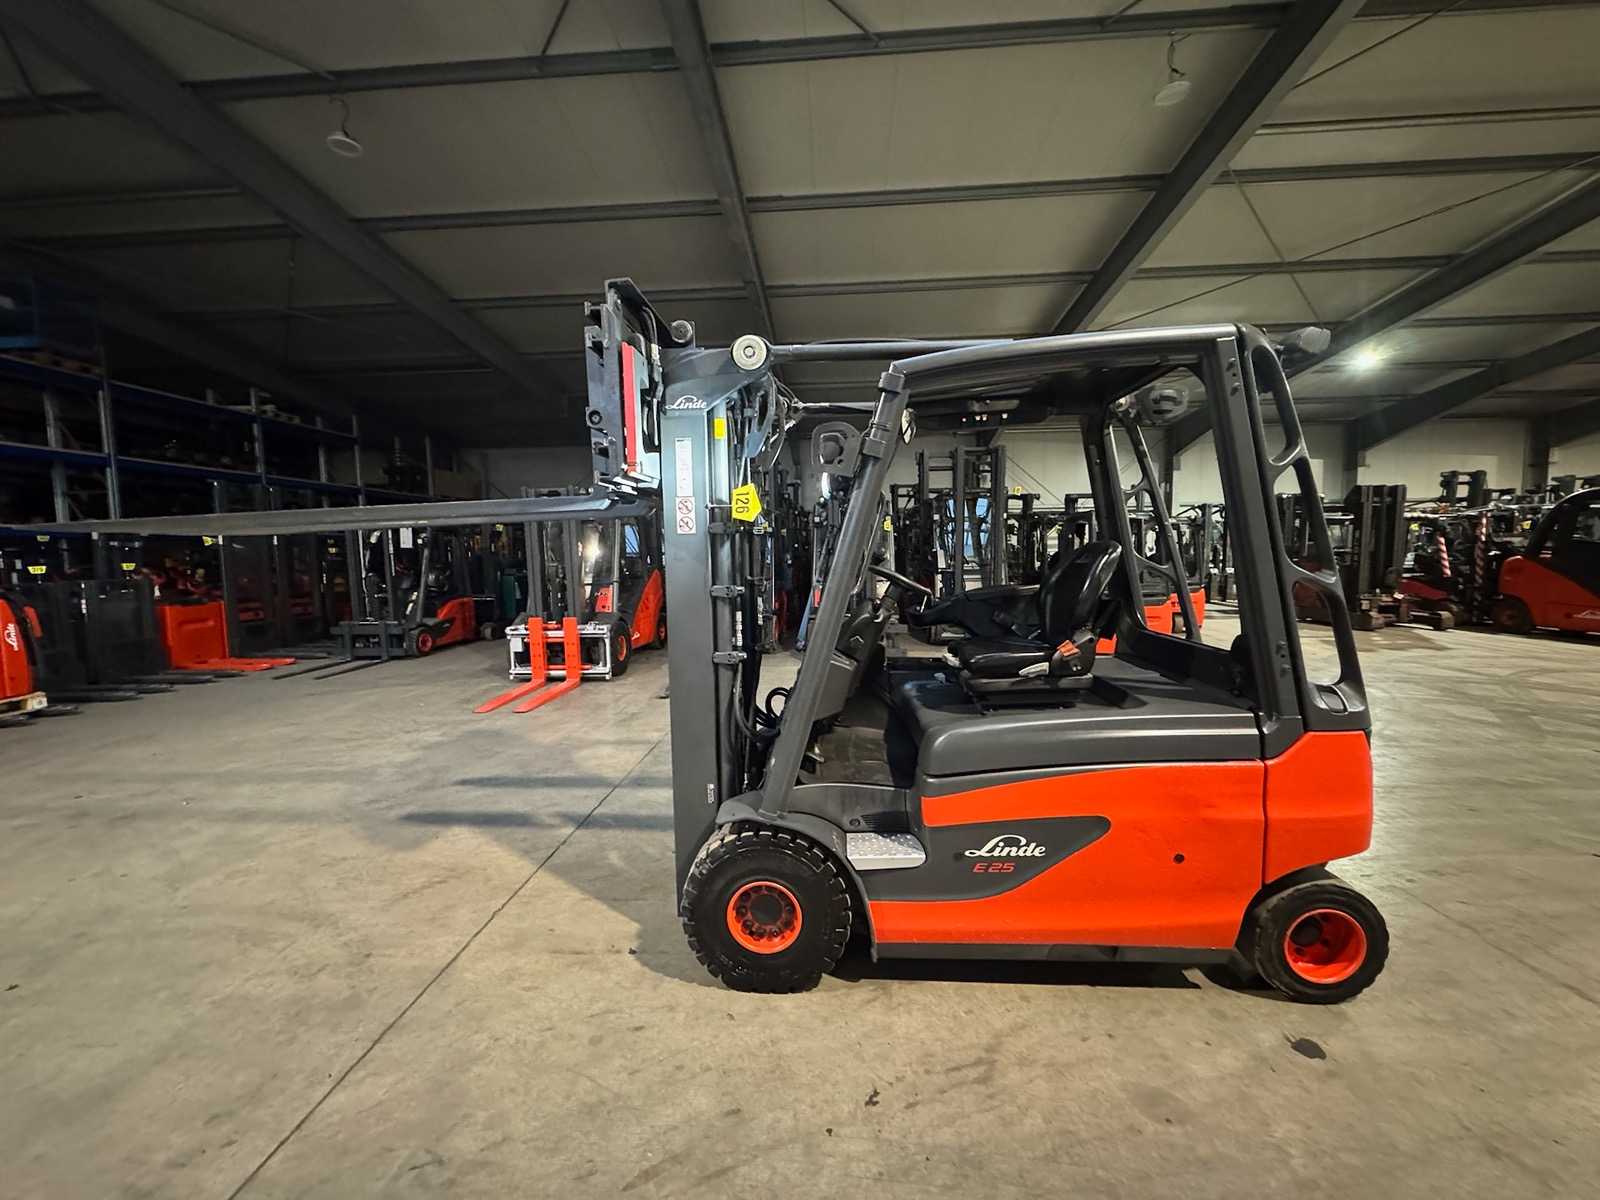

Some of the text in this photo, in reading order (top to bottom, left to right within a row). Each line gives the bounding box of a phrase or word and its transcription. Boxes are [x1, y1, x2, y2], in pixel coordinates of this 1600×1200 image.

[665, 395, 707, 409] Linde
[735, 491, 750, 514] 126
[964, 834, 1046, 857] Linde
